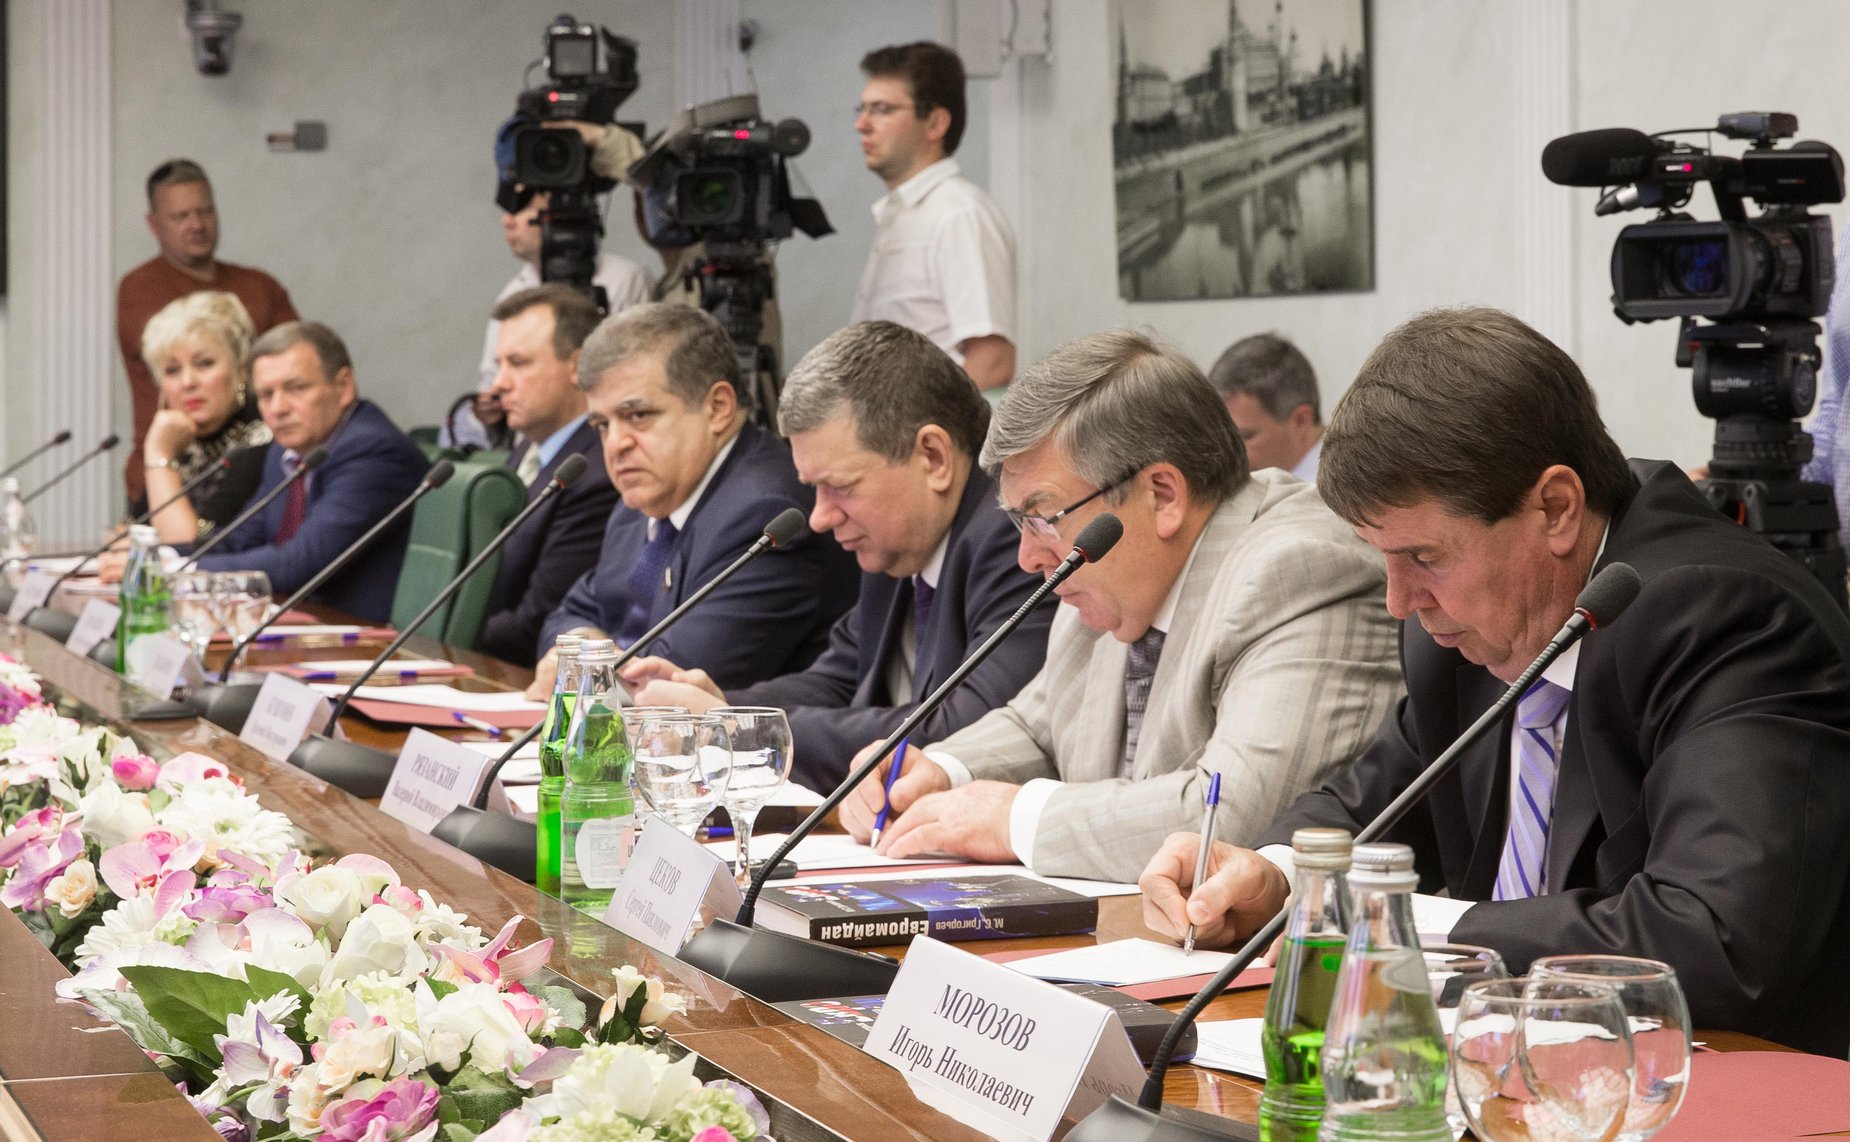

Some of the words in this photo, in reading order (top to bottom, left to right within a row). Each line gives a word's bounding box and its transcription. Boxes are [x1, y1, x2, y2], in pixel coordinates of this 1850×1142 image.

[649, 857, 681, 895] ЦЕКОВ
[625, 888, 648, 918] Сергей
[640, 902, 672, 941] Павлович
[821, 918, 929, 941] Евромайдан
[935, 917, 981, 930] Григорьев
[933, 984, 1036, 1051] МОРОЗОВ
[888, 1024, 934, 1072] Игорь
[933, 1045, 1035, 1117] Николаевич
